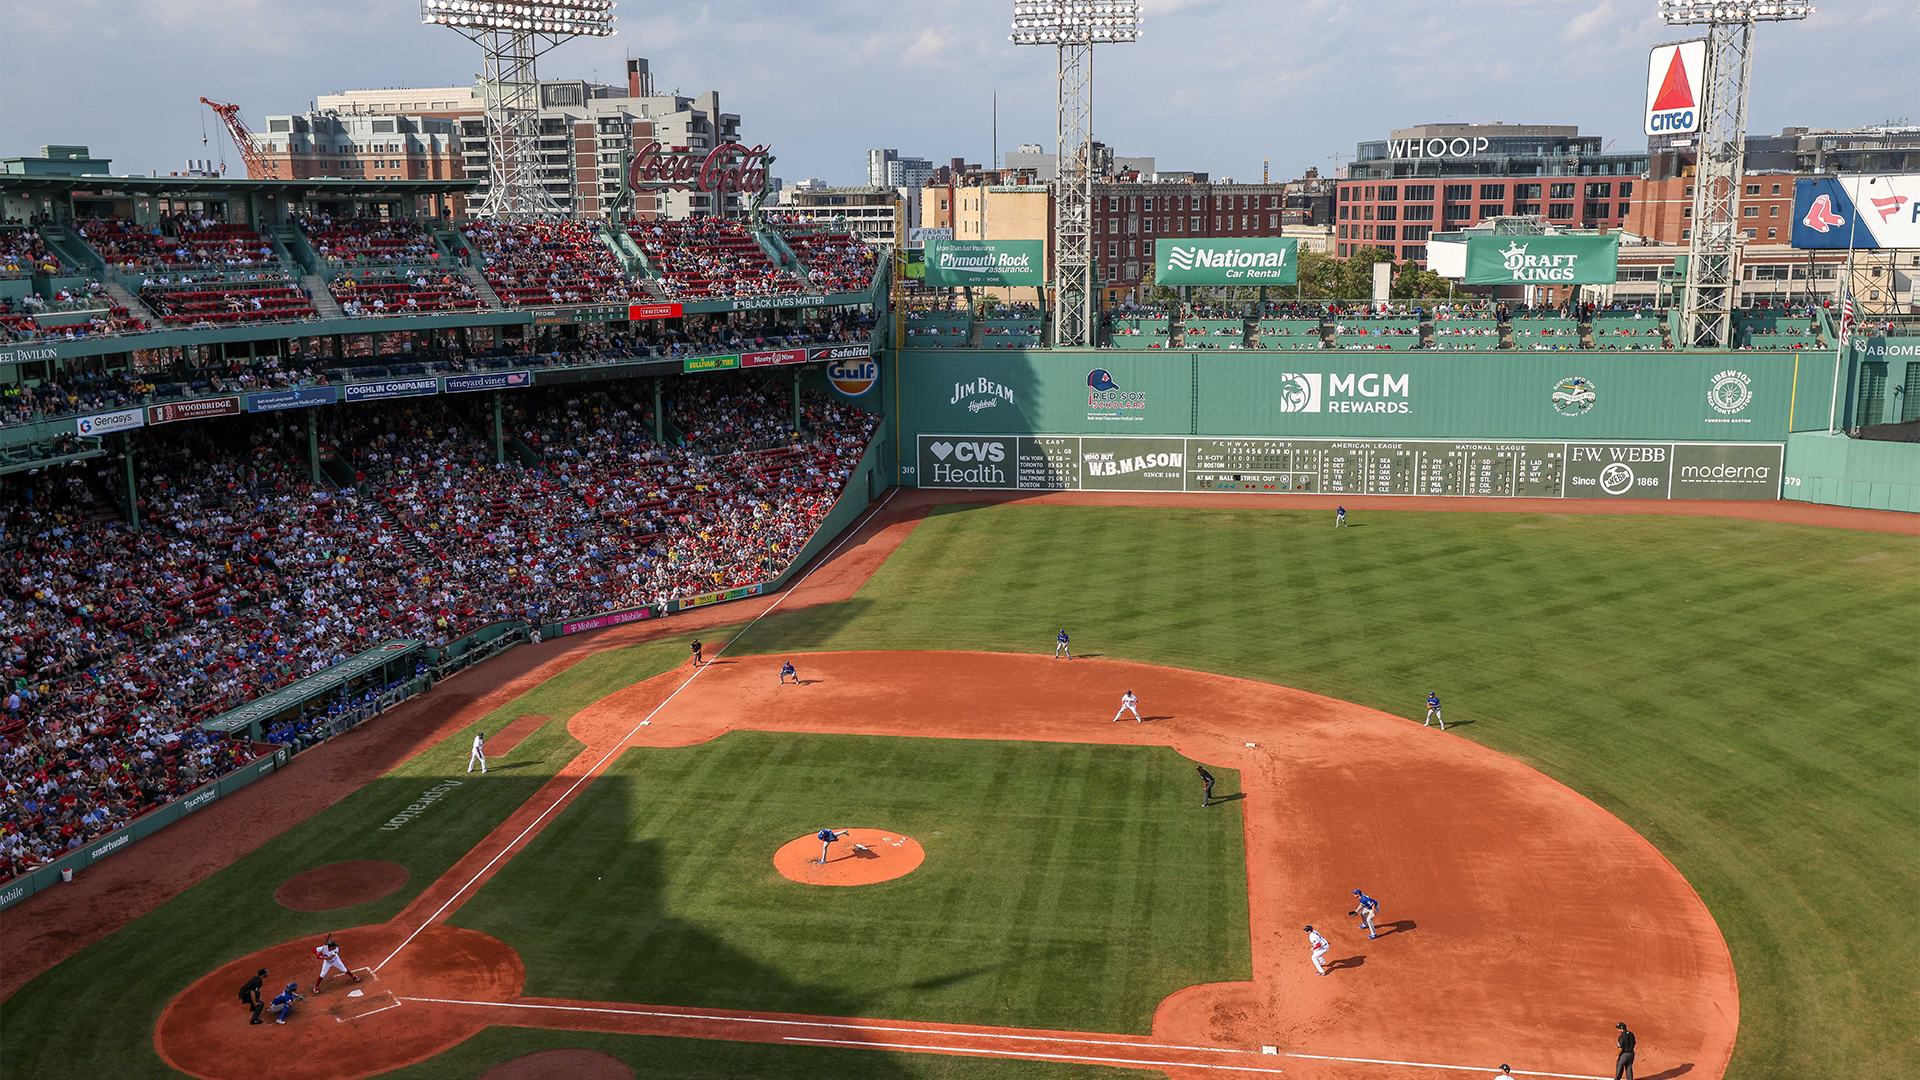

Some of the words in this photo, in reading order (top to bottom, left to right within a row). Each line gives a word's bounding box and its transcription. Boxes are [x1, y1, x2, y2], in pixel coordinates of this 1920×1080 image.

[1651, 111, 1693, 131] CITGO
[1387, 136, 1489, 158] WHOOP
[940, 253, 996, 268] Plymouth
[998, 253, 1030, 266] Rock
[1503, 254, 1578, 270] DRAFT
[1226, 269, 1244, 278] Car
[1246, 269, 1281, 278] Rental
[1513, 268, 1575, 280] KINGS
[745, 300, 772, 309] BLACK
[772, 299, 794, 307] LIVES
[796, 297, 825, 305] MATTER
[17, 348, 58, 361] PAVILION
[754, 355, 772, 364] Ninety
[830, 347, 868, 358] Safelite
[689, 359, 715, 369] SULLIVAN
[723, 358, 734, 366] TIRE
[829, 363, 875, 379] Gulf
[1710, 369, 1737, 384] IBEW
[1736, 371, 1752, 385] 103
[347, 385, 385, 395] COGHLIN
[386, 380, 436, 392] COMPANIES
[449, 379, 484, 390] vineyard
[483, 377, 506, 386] vines
[1329, 373, 1409, 398] MGM
[951, 382, 975, 405] JIM
[978, 377, 1015, 405] BEAM
[1093, 392, 1116, 401] RED
[1120, 392, 1145, 401] SOX
[177, 400, 232, 412] WOODBRIDGE
[968, 397, 997, 414] Highball
[1092, 401, 1145, 409] SCHOLARS
[1328, 401, 1409, 414] REWARDS
[94, 413, 133, 427] Genasys
[954, 441, 1005, 462] CVS
[1100, 453, 1114, 461] BUT
[1609, 447, 1666, 462] WEBB
[933, 463, 1006, 483] Health
[1681, 463, 1767, 479] moderna
[1572, 476, 1596, 486] Since
[1636, 477, 1659, 487] 1866
[1784, 476, 1802, 487] 379
[621, 611, 643, 622] Mobile
[578, 620, 600, 631] Mobile
[184, 789, 215, 809] TouchView
[380, 779, 464, 831] Aspiration
[91, 833, 130, 859] smartwater
